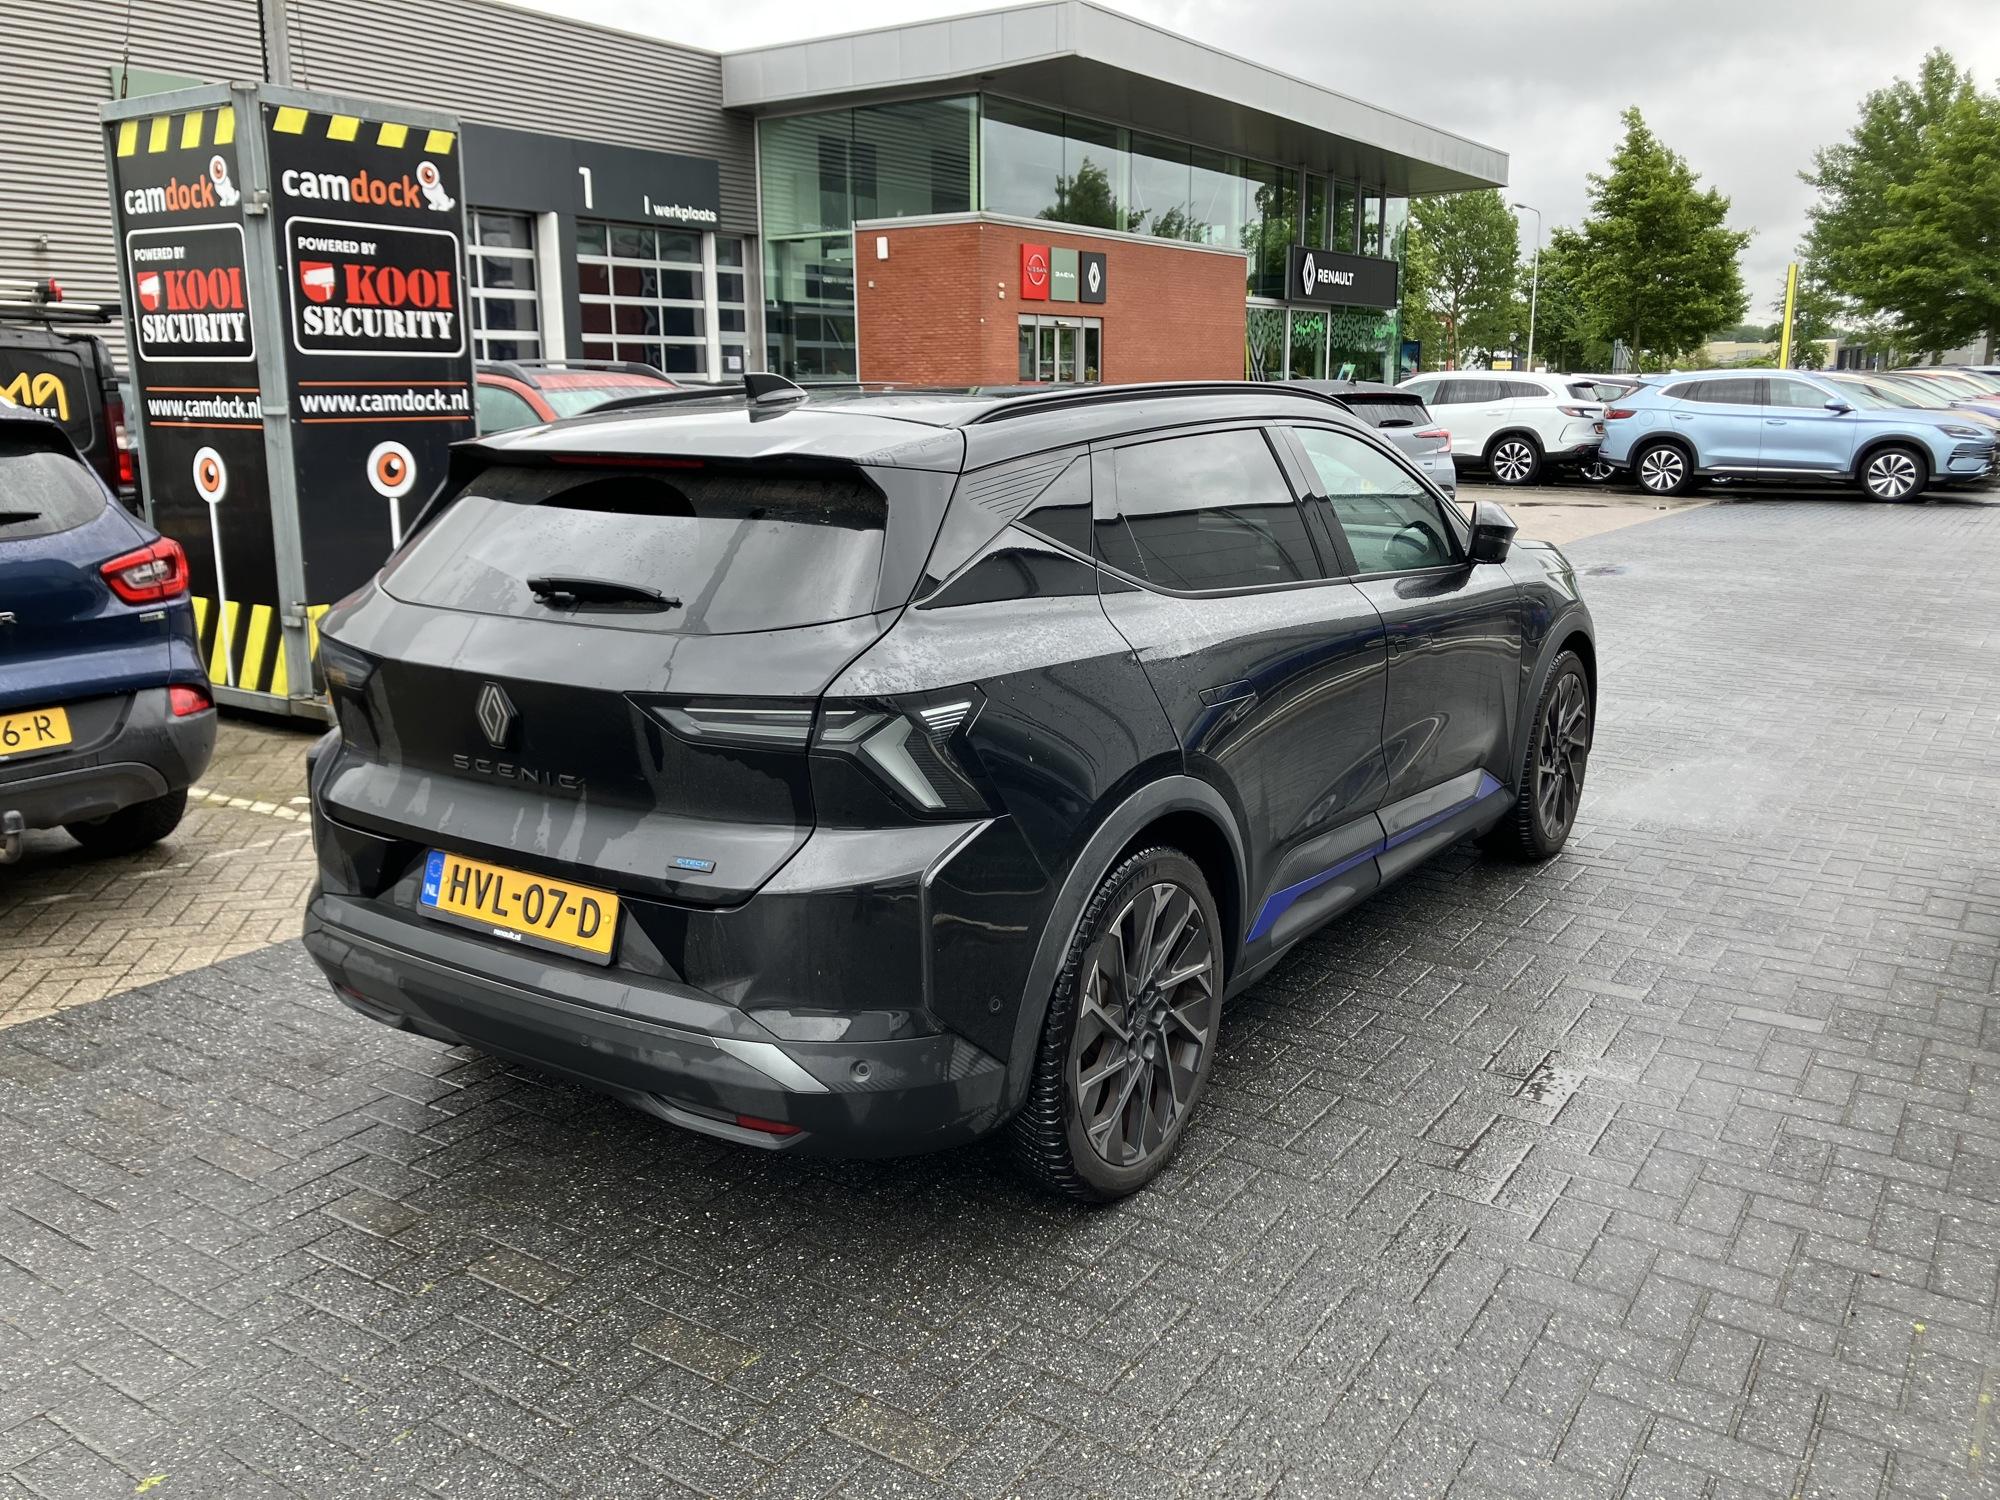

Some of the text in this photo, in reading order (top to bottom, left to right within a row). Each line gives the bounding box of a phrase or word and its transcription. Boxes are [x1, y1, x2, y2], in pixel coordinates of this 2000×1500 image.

[124, 174, 215, 215] camdock
[281, 169, 421, 209] camdock
[578, 166, 593, 210] 1
[653, 203, 717, 222] werkplaats
[134, 246, 185, 262] POWERED BY
[297, 236, 377, 256] POWERED BY
[343, 263, 453, 309] KOOI
[1026, 265, 1048, 274] NISSAN
[1317, 268, 1354, 286] RENAULT
[163, 267, 244, 310] KOOI
[141, 312, 246, 344] SECURITY
[302, 305, 454, 340] SECURITY
[147, 395, 262, 419] www.camdock.nl
[299, 388, 470, 414] www.camdock.nl
[453, 753, 585, 790] SCENIC
[425, 864, 601, 939] NL HVL-07-D
